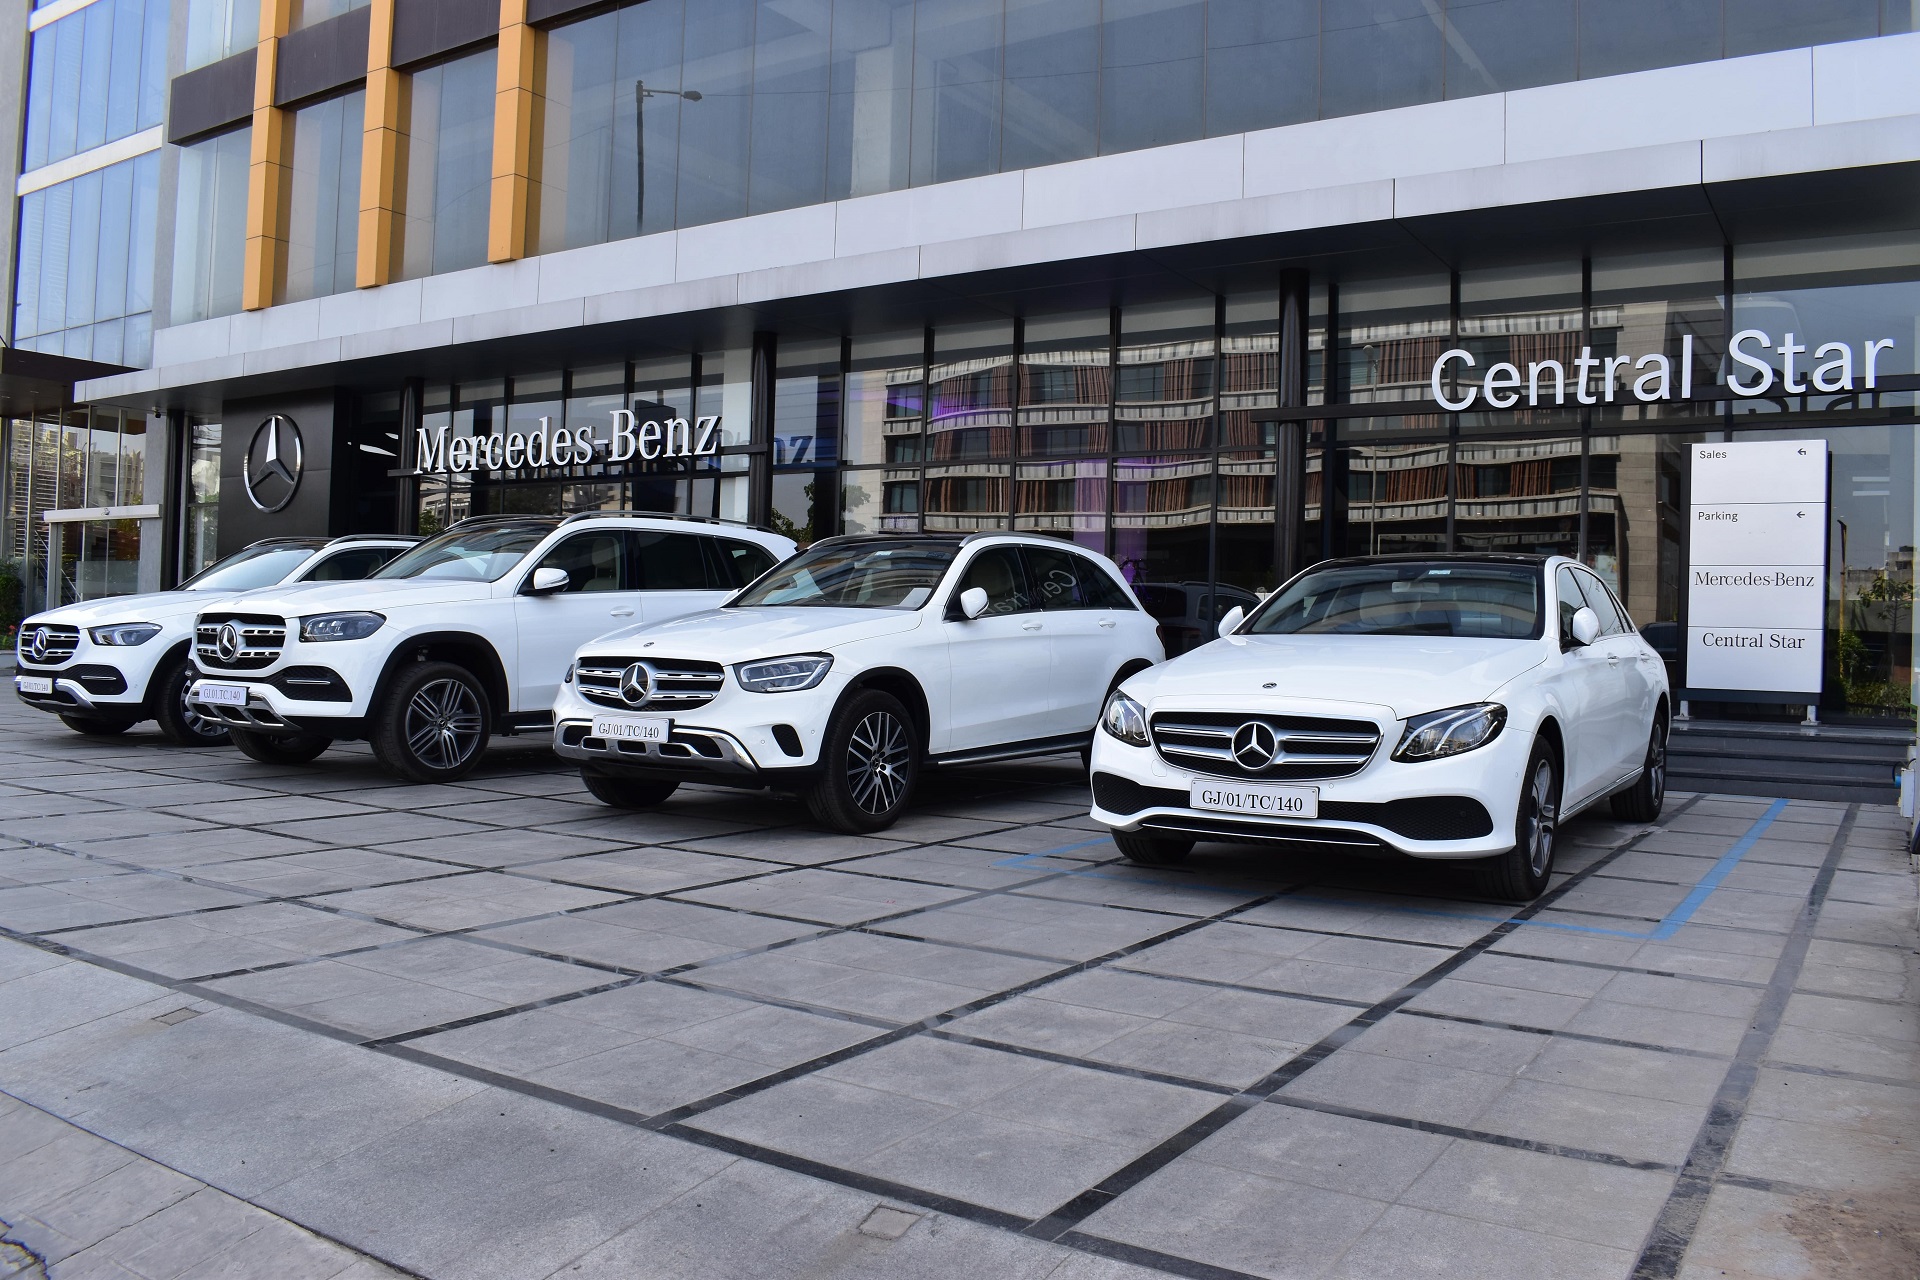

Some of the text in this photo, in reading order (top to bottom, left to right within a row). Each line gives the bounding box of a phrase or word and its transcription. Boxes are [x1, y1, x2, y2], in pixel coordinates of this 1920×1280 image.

[1431, 334, 1692, 411] Central
[1726, 329, 1894, 397] Star
[413, 409, 723, 474] Mercedes-Benz
[1699, 450, 1727, 459] Sales
[1698, 511, 1738, 523] Parking
[1694, 571, 1815, 587] Mercedes-Benz
[1702, 632, 1805, 649] Central Star
[598, 722, 660, 738] GJ/01/TC/140
[1202, 790, 1303, 811] GJ/01/TC/140
